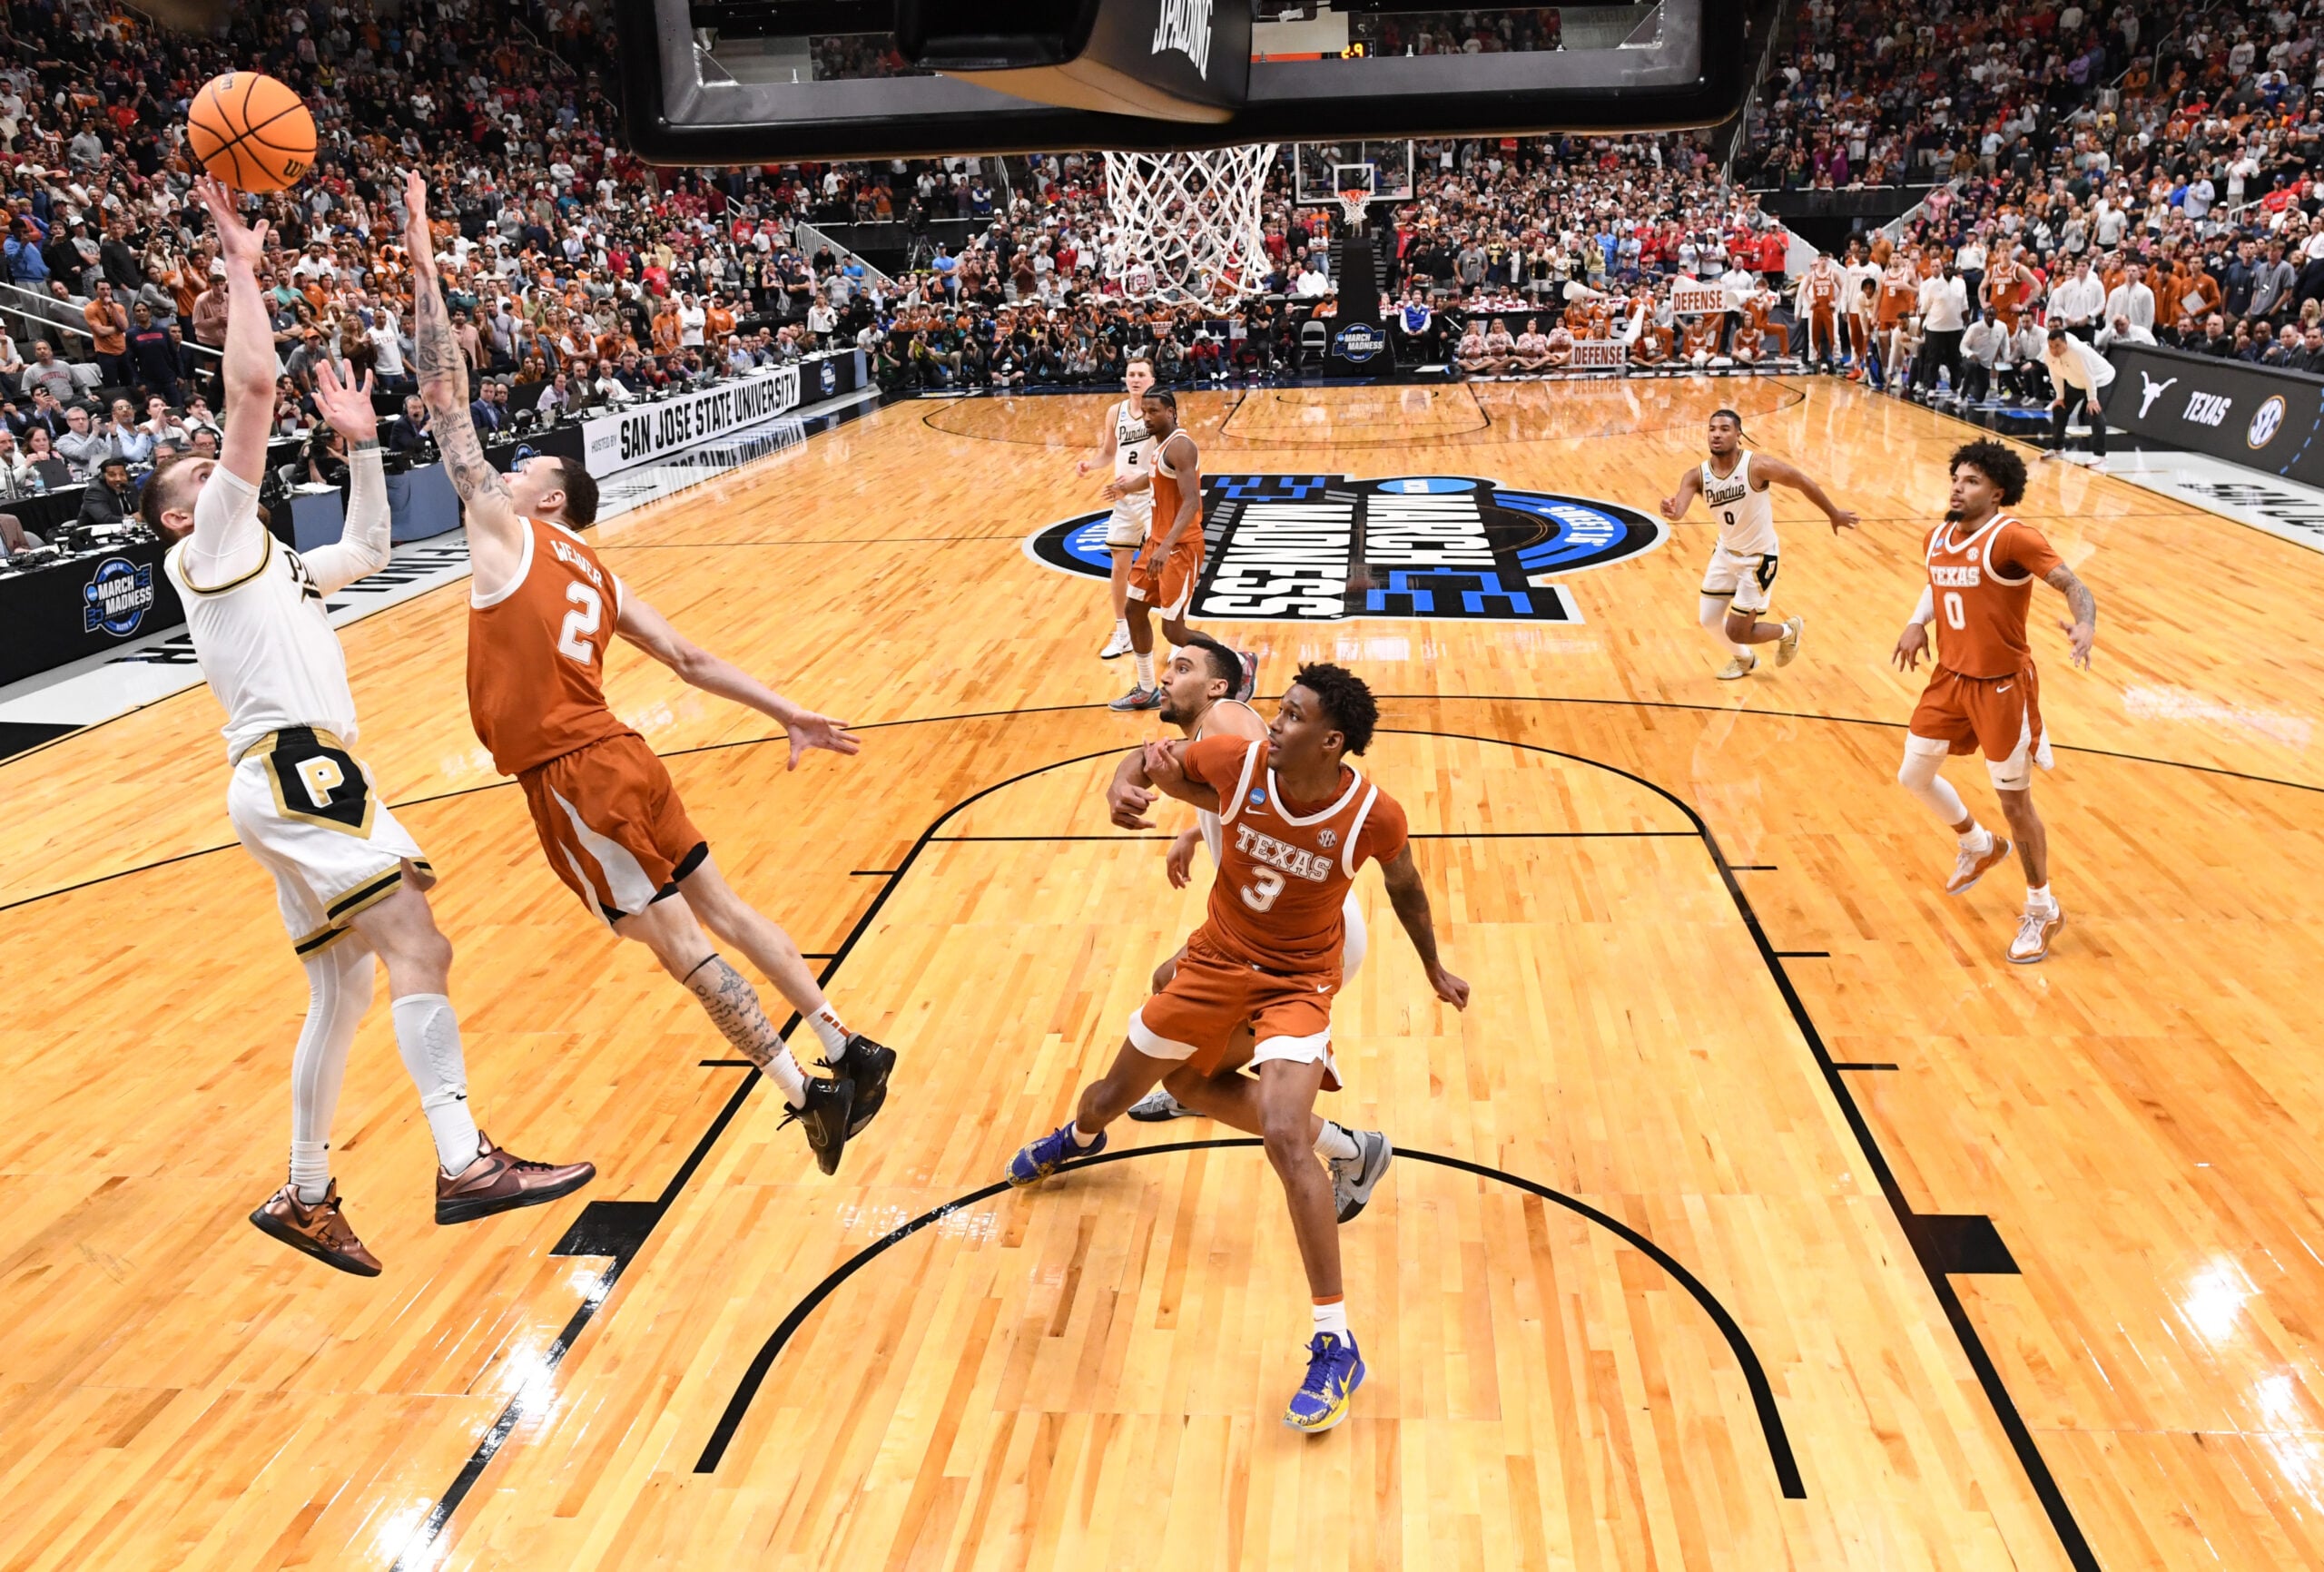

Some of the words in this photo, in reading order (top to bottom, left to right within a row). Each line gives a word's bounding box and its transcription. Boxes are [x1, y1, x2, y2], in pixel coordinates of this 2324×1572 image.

[1673, 290, 1722, 311] DEFENSE
[1817, 286, 1829, 296] 33
[1344, 333, 1371, 343] MARCH
[1347, 341, 1384, 350] MADNESS
[1574, 346, 1622, 365] DEFENSE
[591, 437, 611, 454] HOSTED
[611, 435, 617, 447] BY
[620, 414, 651, 461] SAN
[655, 403, 692, 449] JOSE
[695, 391, 732, 435] STATE
[734, 372, 797, 423] UNIVERSITY
[2182, 390, 2232, 427] TEXAS
[1118, 425, 1151, 441] Purdu
[2251, 399, 2280, 446] SEC
[1128, 451, 1138, 465] 2
[1705, 484, 1746, 504] Purdue
[1364, 494, 1496, 565] MARCH
[1537, 506, 1614, 531] SWEET
[1724, 511, 1735, 526] 0
[550, 540, 603, 588] WEAVER
[1201, 504, 1354, 616] MADNESS
[98, 575, 134, 601] MARCH
[1929, 565, 1981, 587] TEXAS
[105, 585, 153, 615] MADNESS
[1944, 592, 1966, 630] 0
[558, 580, 602, 665] 2
[295, 755, 345, 809] P
[1318, 829, 1336, 848] SEC
[1235, 822, 1334, 883] TEXAS
[1240, 865, 1285, 913] 3
